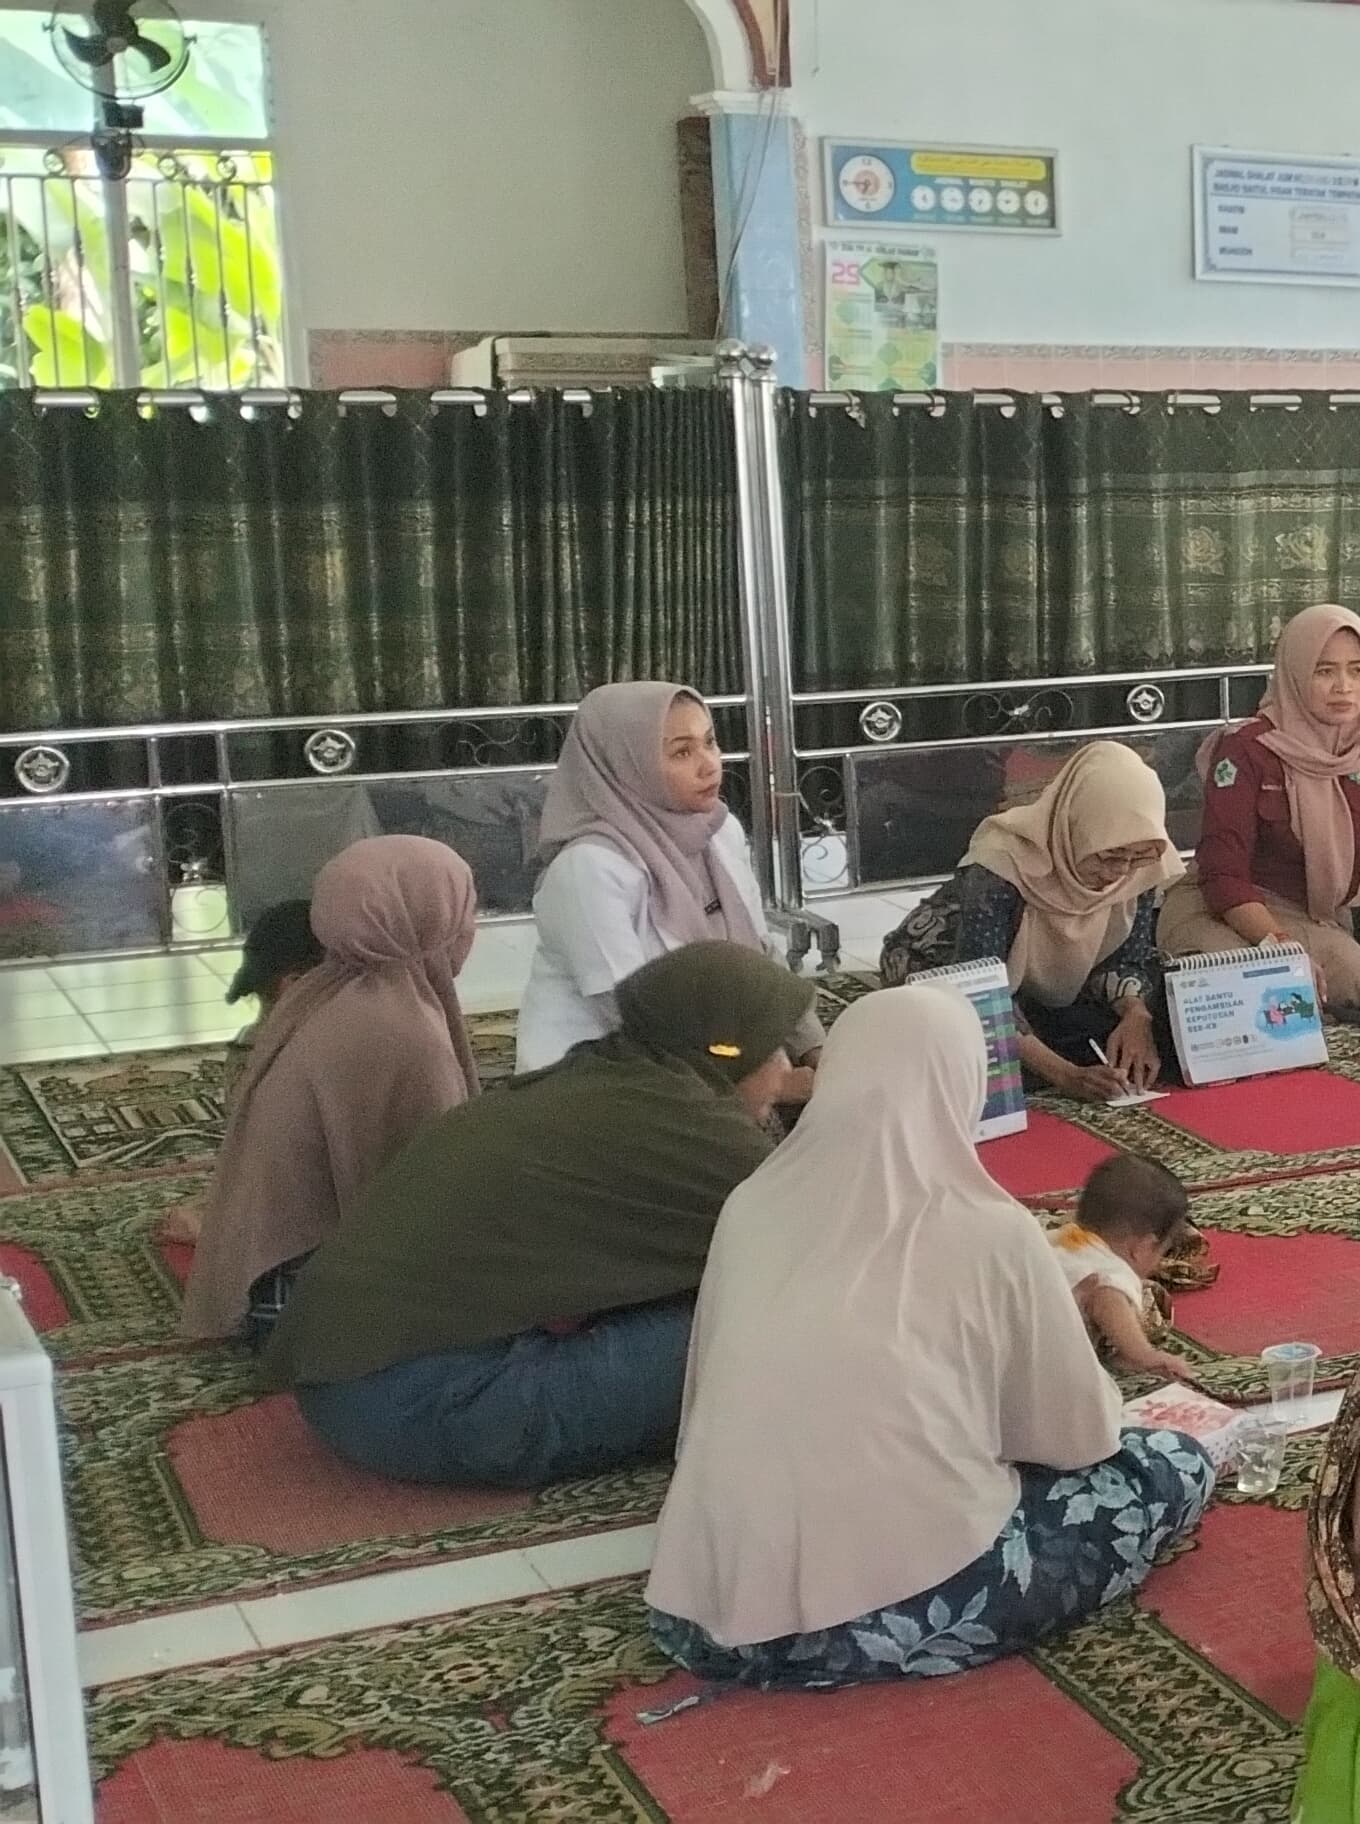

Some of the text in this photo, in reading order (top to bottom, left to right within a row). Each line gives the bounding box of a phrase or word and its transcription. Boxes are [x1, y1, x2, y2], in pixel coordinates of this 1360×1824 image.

[1183, 991, 1234, 1005] ALAT BANTU
[1184, 1000, 1244, 1014] PENGAMBILAN
[1186, 1010, 1235, 1023] KEPUTUSAN
